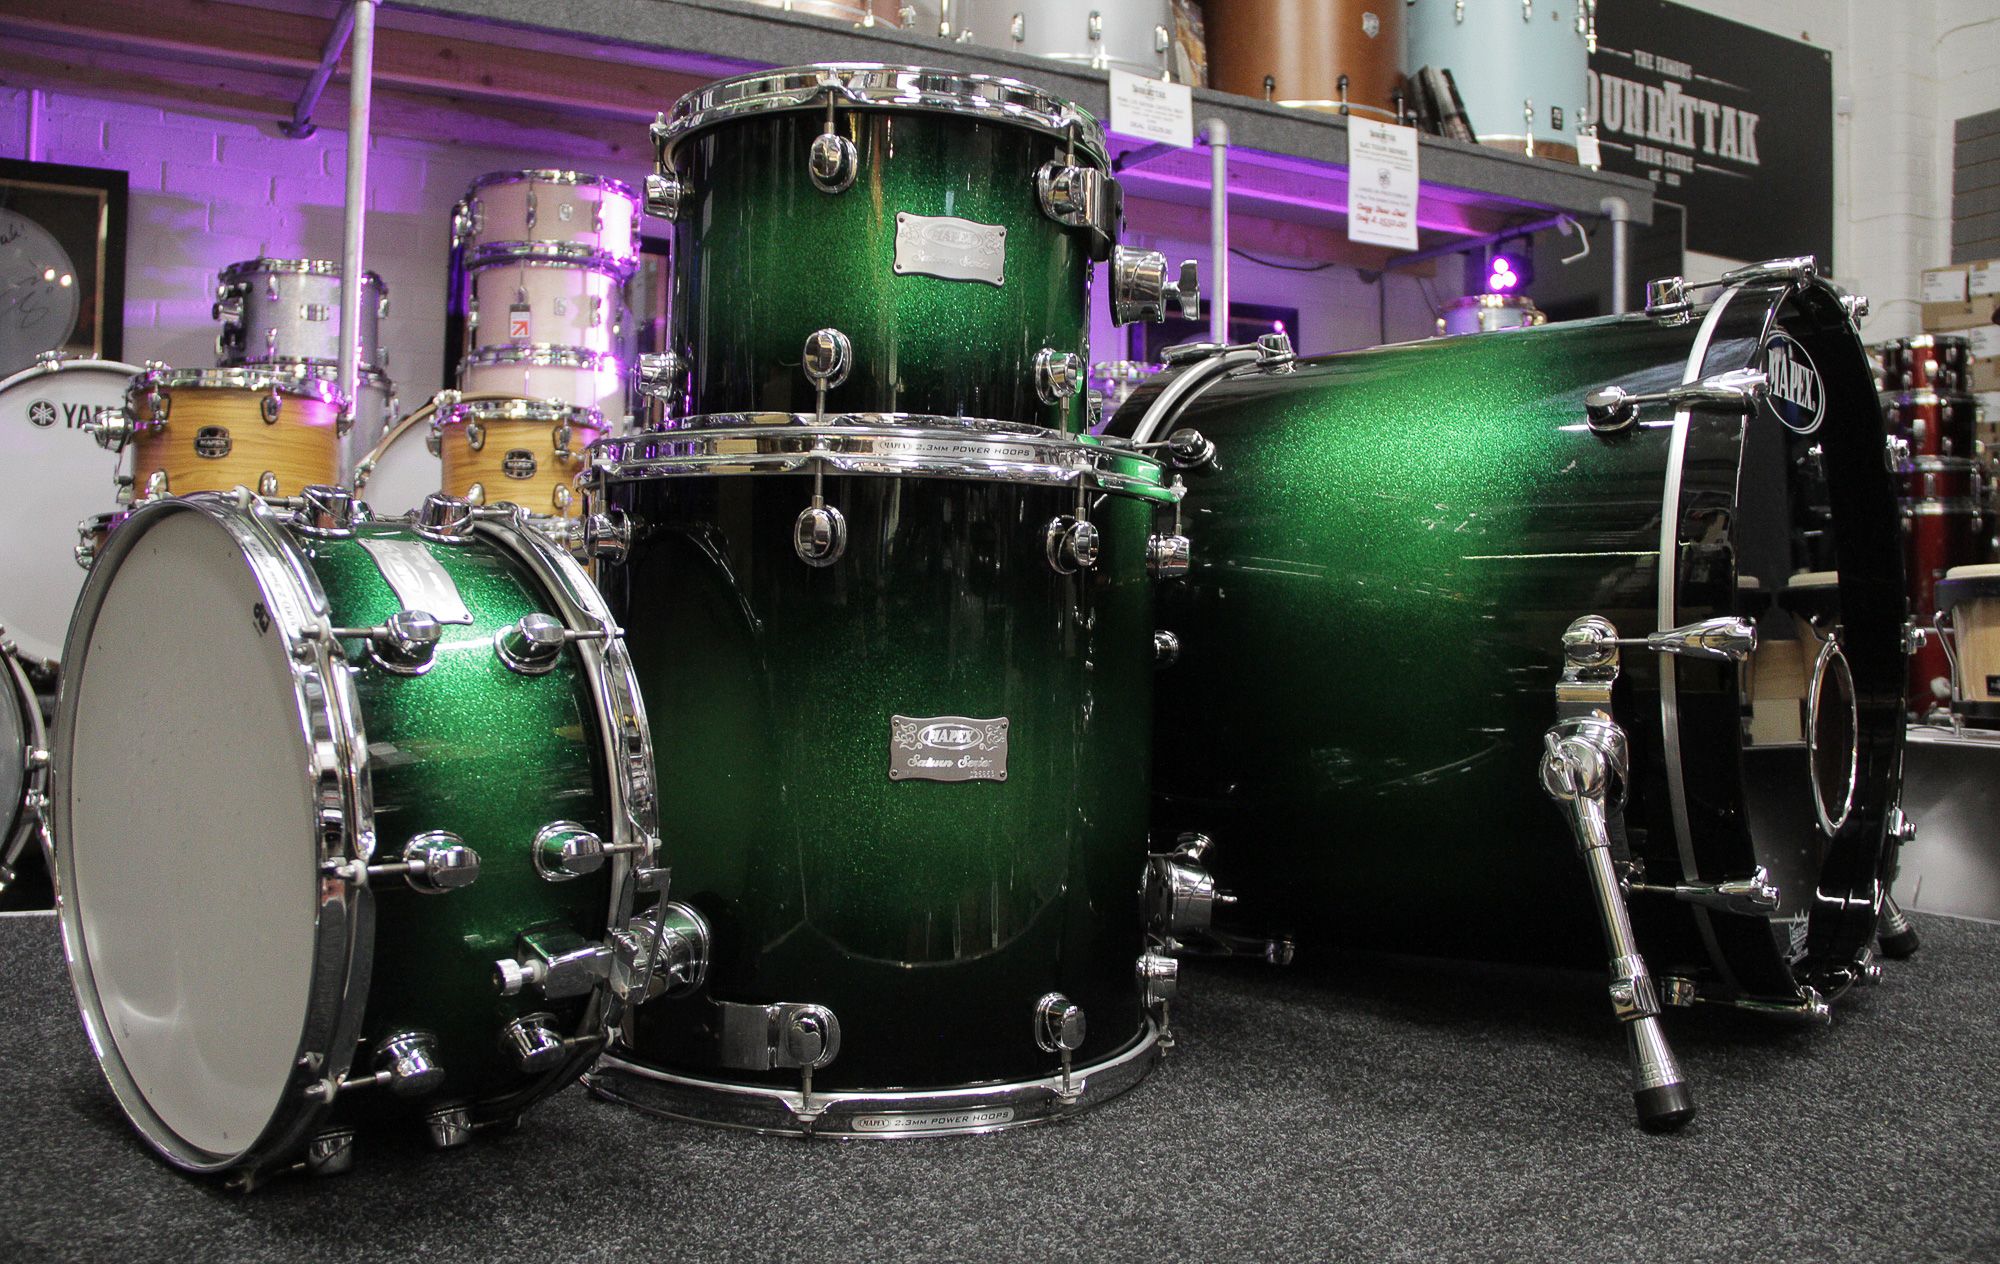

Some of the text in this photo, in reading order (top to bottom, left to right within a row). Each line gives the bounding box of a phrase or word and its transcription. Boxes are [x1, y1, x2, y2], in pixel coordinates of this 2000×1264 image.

[1768, 347, 1815, 412] MAPEX
[952, 445, 991, 454] POWER
[994, 448, 1030, 456] HOOPS
[927, 729, 974, 743] MAPEX
[931, 1115, 969, 1125] POWER
[973, 1111, 1009, 1121] HOOPS
